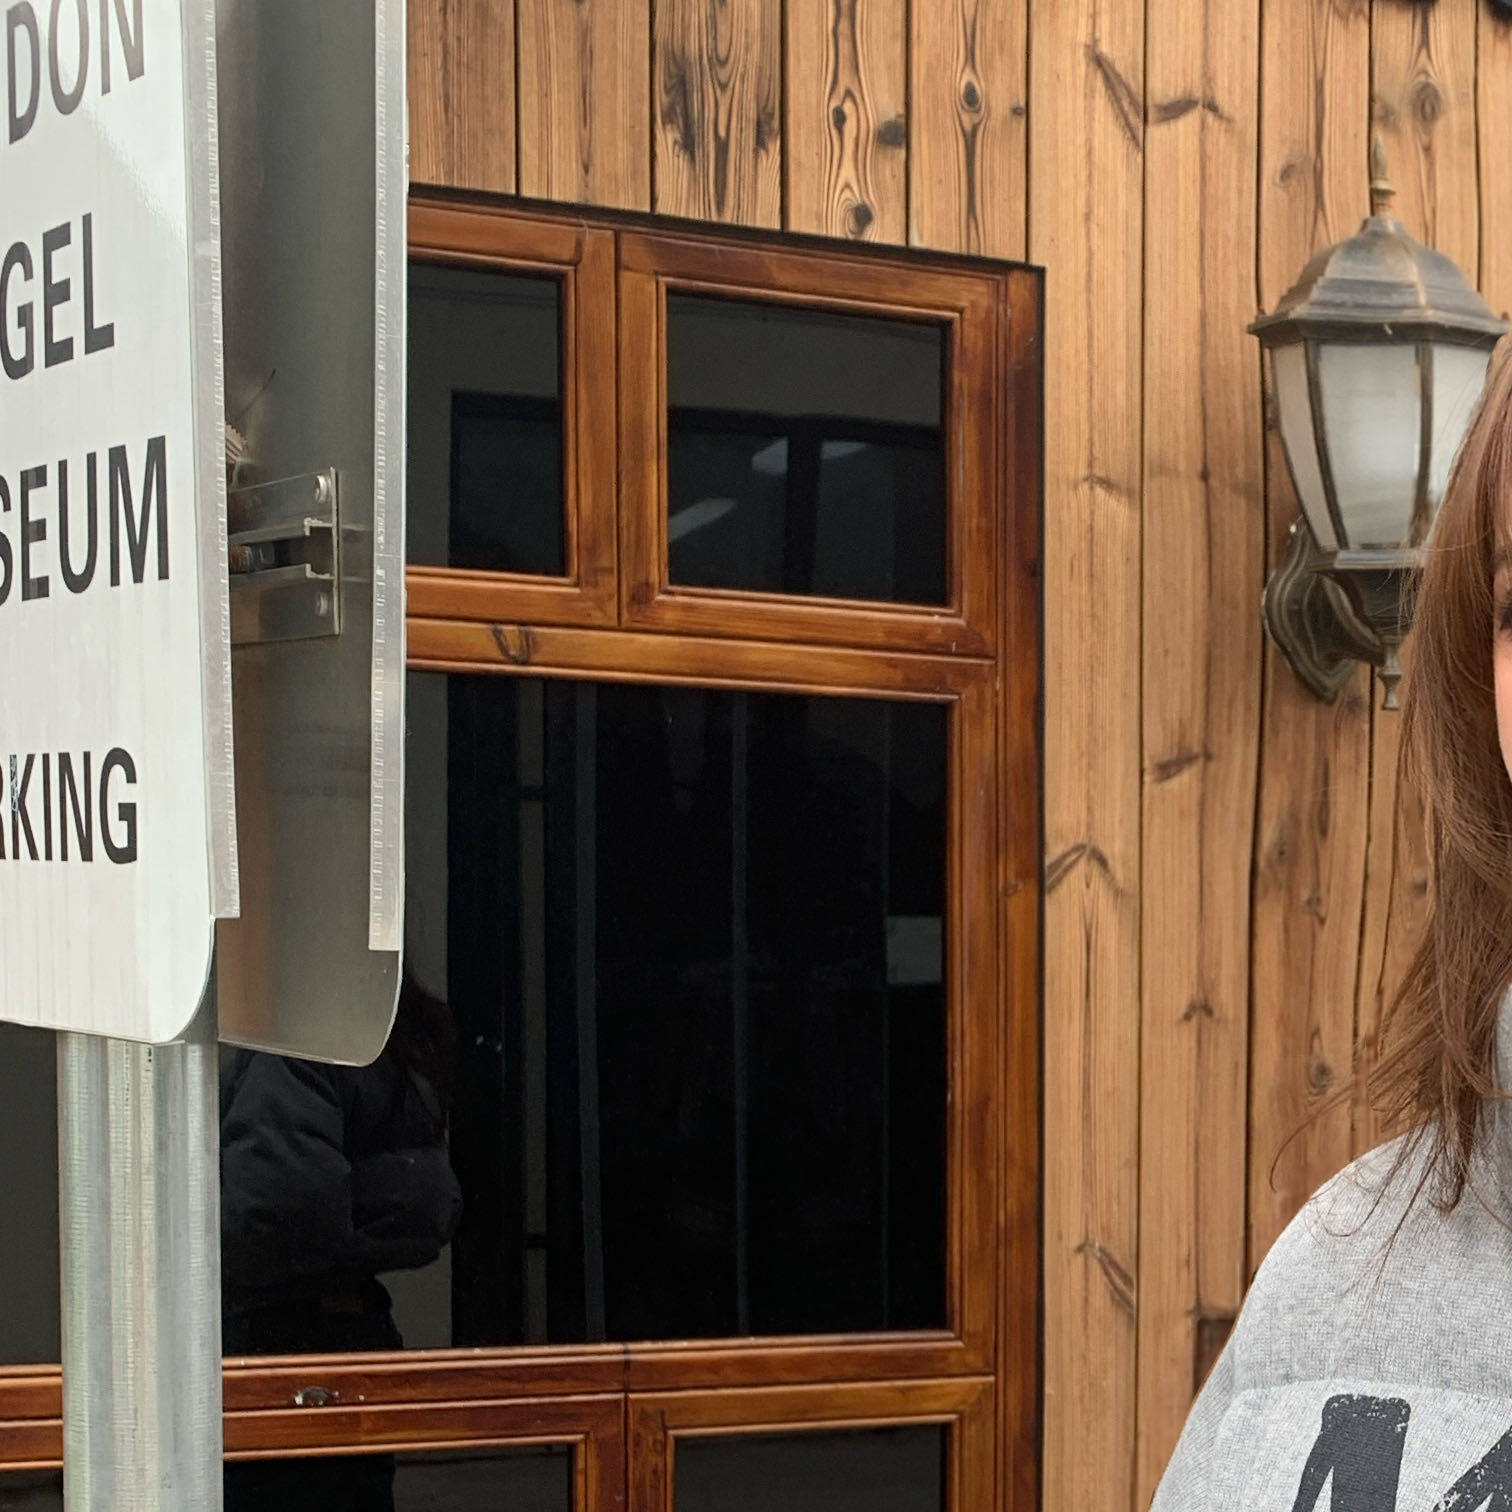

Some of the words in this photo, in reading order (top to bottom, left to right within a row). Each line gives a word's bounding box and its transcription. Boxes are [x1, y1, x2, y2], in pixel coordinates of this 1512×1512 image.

[6, 0, 145, 145] DON
[0, 212, 114, 380] GEL
[0, 747, 138, 864] KING
